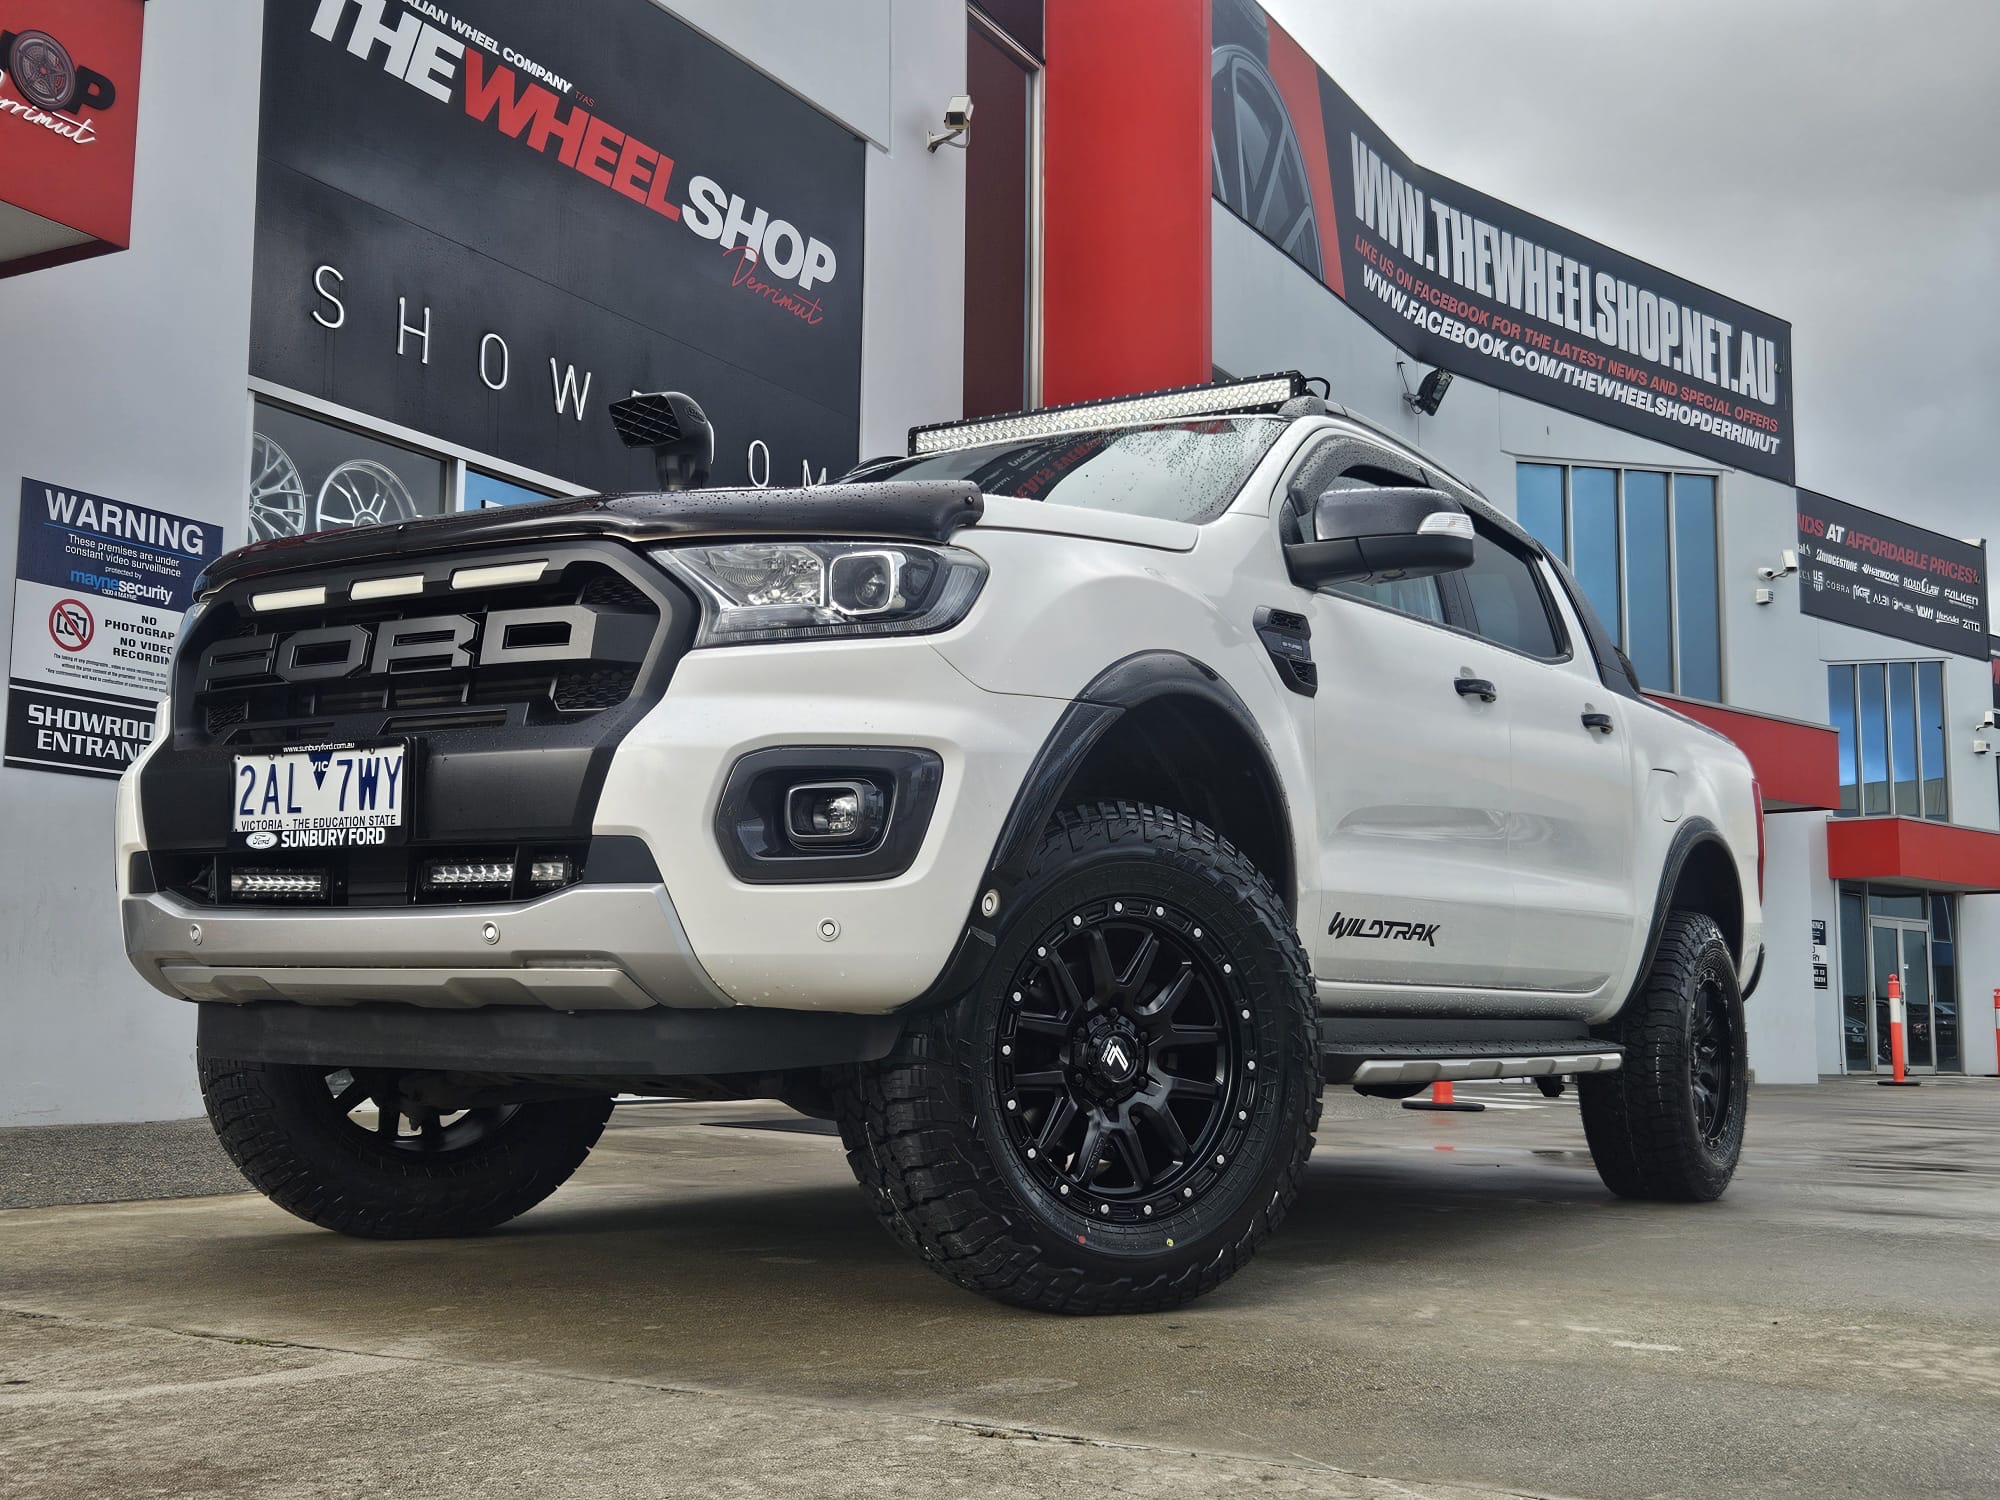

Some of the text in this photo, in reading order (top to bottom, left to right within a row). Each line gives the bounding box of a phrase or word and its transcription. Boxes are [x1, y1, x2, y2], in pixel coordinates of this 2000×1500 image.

[451, 16, 500, 55] WHEEL
[503, 47, 573, 94] COMPANY
[722, 246, 824, 324] Derrimut
[1350, 131, 1777, 406] WWW.THEWHEELSHOP.NET.AU
[1354, 234, 1780, 432] LIKE US ON FACEBOOK FOR THE LATEST NEWS AND SPECIAL OFFERS
[1363, 264, 1780, 455] WWW.FACEBOOK.COM/THEWHEELSHOPDERRIMUT
[45, 488, 204, 555] WARNING
[66, 545, 182, 578] constant video surveillance
[68, 533, 180, 567] These premises are under
[1826, 523, 1845, 543] AT
[1846, 530, 1928, 571] AFFORDABLE
[70, 570, 173, 604] maynesecurity
[104, 566, 142, 580] protected by
[141, 615, 156, 626] NO
[120, 636, 136, 648] NO
[204, 604, 598, 692] FORD
[283, 742, 354, 754] www.sunburyford.com.au
[312, 761, 329, 772] VIC
[240, 756, 403, 816] 2AL 7WY
[240, 819, 282, 830] VICTORIA
[292, 818, 310, 829] THE
[313, 816, 366, 828] EDUCATION
[368, 814, 396, 826] STATE
[280, 828, 348, 848] SUNBURY
[348, 827, 386, 846] FORD
[1328, 912, 1440, 947] WILDTRAK
